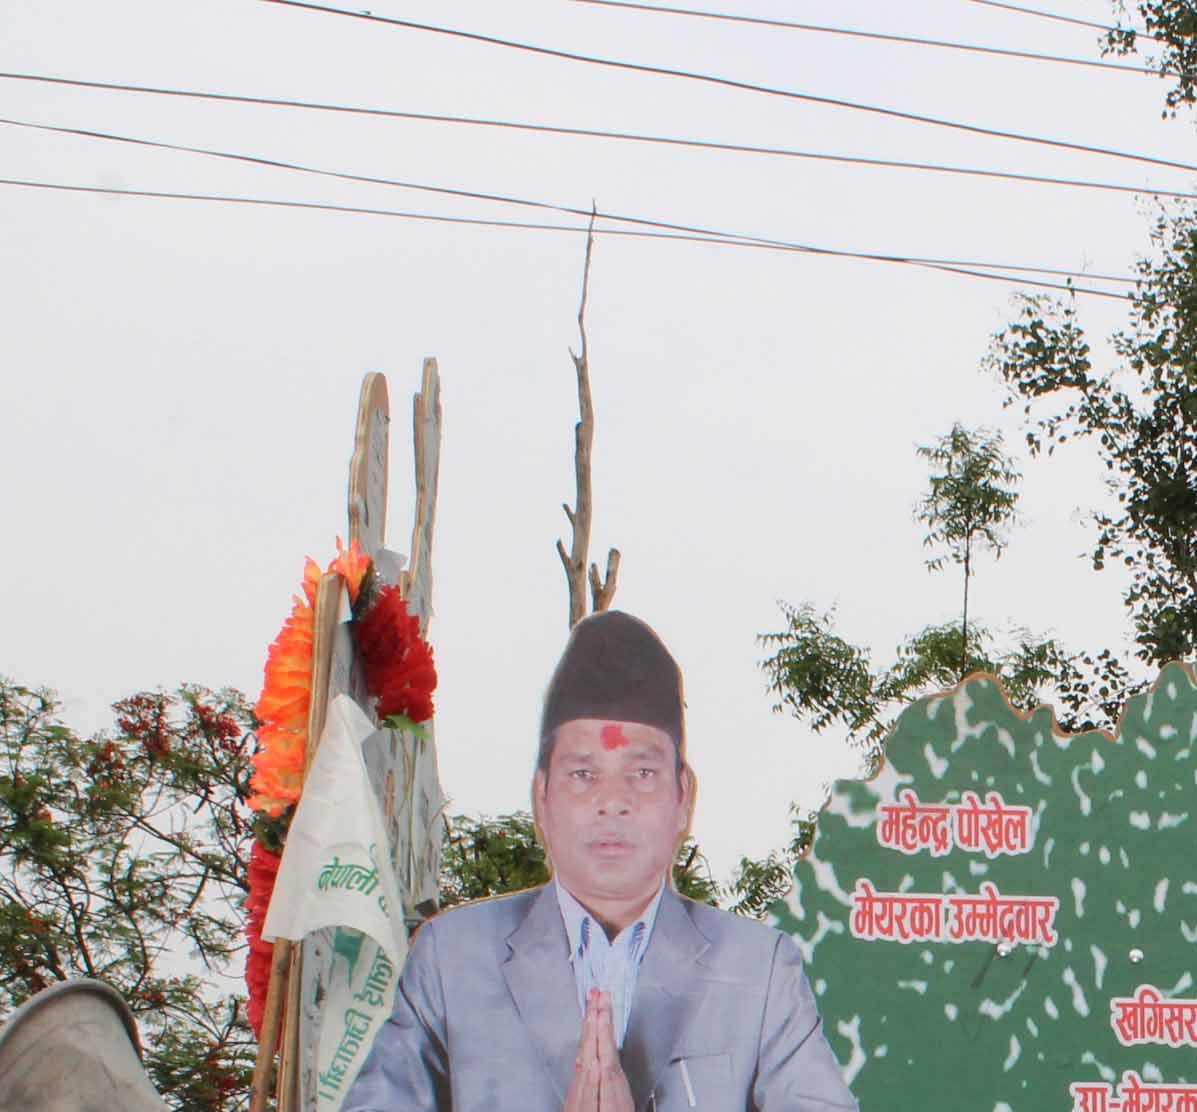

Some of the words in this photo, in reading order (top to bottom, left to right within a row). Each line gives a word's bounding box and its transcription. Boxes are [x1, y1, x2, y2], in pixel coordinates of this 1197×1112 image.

[880, 792, 951, 852] महेन्द्र
[956, 794, 1030, 854] पोख्रेल
[854, 882, 943, 941] मेयरका
[948, 884, 1057, 944] उम्मेदवार
